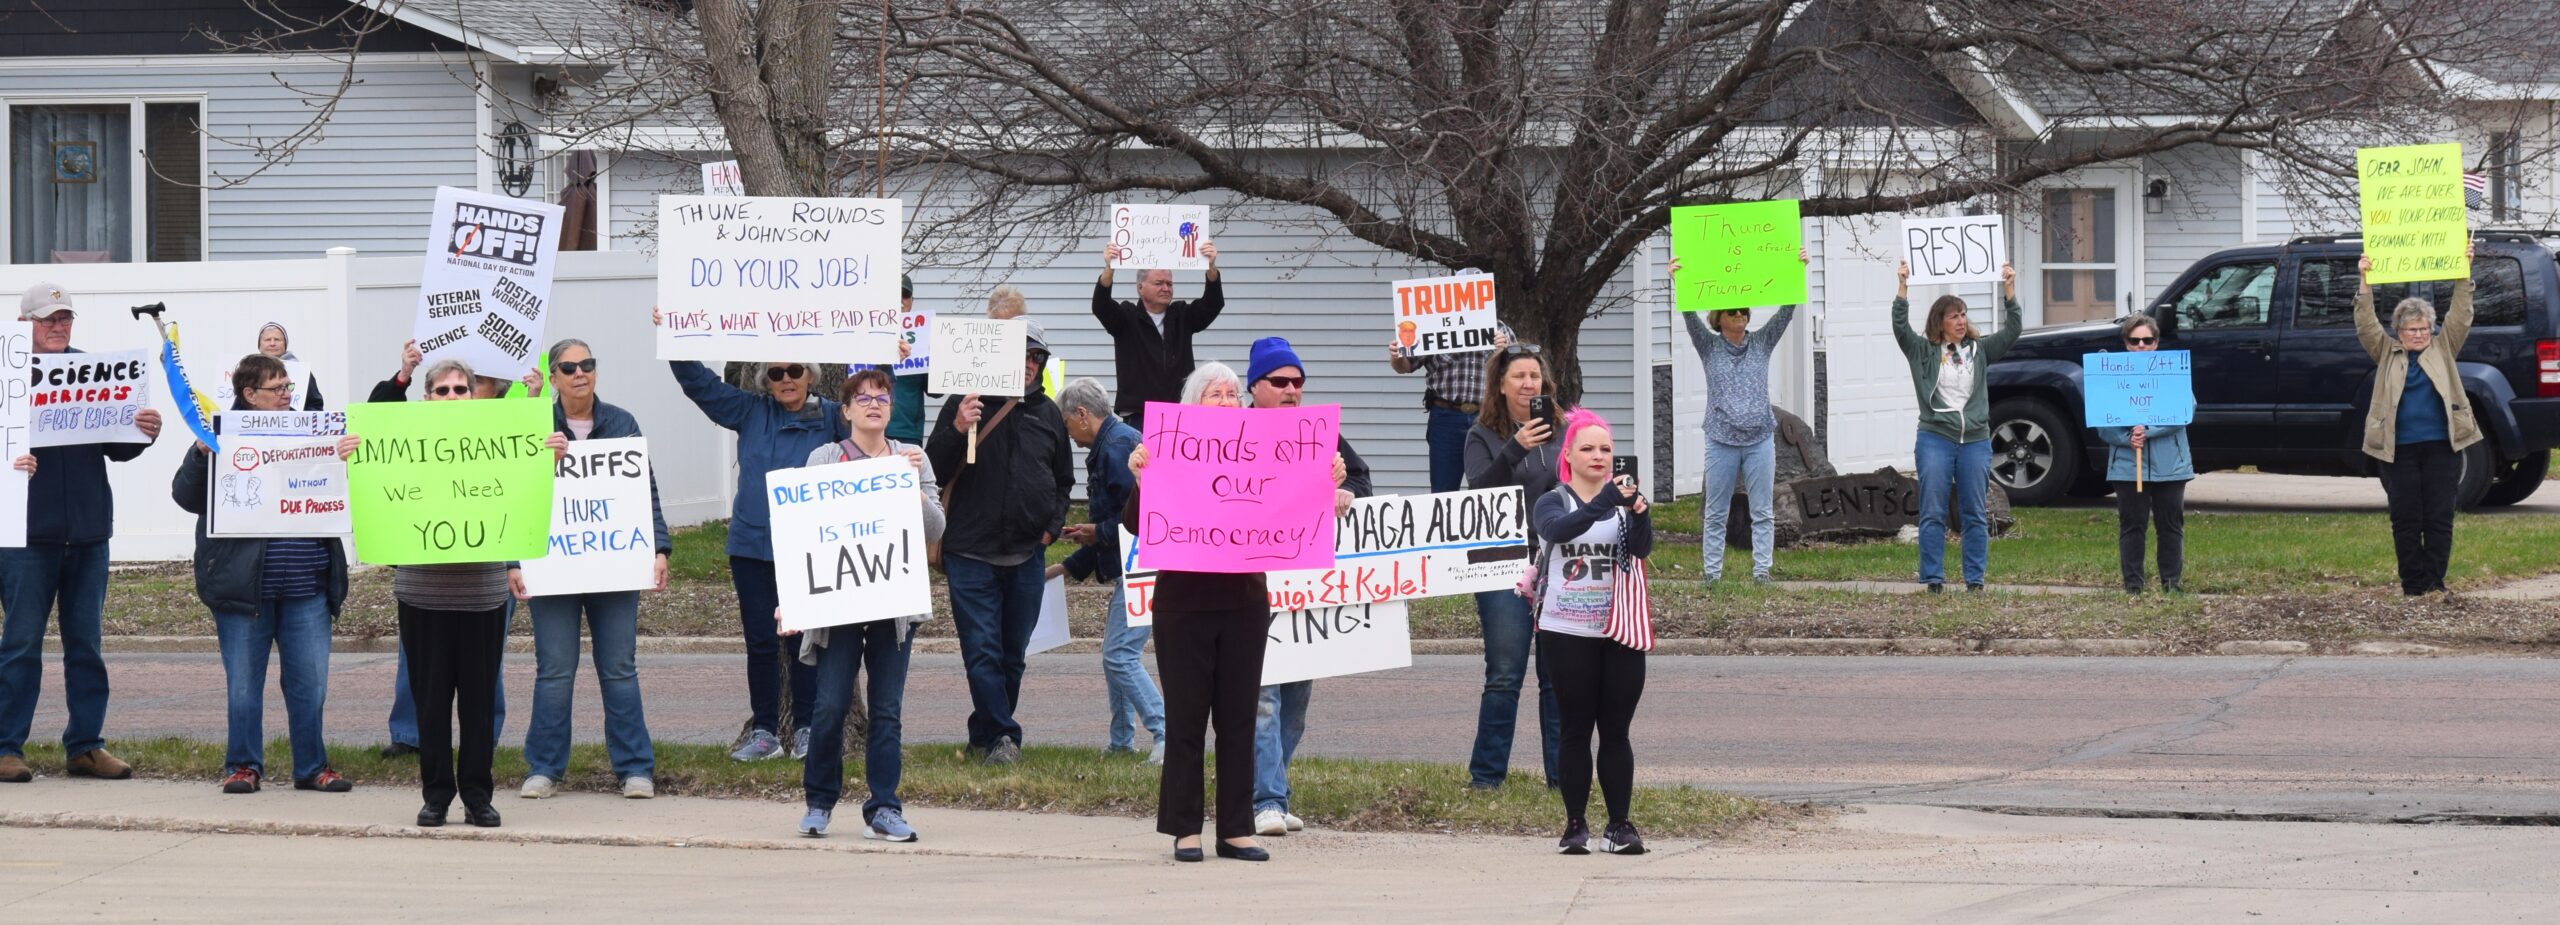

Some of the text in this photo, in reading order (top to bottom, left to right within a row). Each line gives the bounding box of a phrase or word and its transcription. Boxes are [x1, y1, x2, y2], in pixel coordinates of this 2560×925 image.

[2367, 159, 2401, 178] DEAR
[2377, 183, 2455, 200] WE ARE OVER
[457, 205, 540, 234] HANDS
[792, 202, 886, 225] ROUNDS
[1115, 207, 1171, 229] Grand
[716, 223, 831, 244] & JOHNSON
[1693, 213, 1776, 241] Thune
[454, 223, 538, 263] OFF!
[1115, 229, 1178, 253] Oligarchy
[1728, 242, 1796, 256] is afraid
[1908, 223, 1998, 276] RESIST
[2421, 232, 2447, 247] WITH
[447, 257, 535, 278] NATIONAL DAY OF ACTION
[1119, 247, 1159, 269] Party
[1725, 262, 1743, 274] of
[2398, 256, 2411, 272] IS
[691, 253, 869, 290] DO YOUR JOB!
[427, 289, 481, 307] VETERAN
[491, 287, 538, 322] WORKERS
[496, 276, 543, 313] POSTAL
[1396, 279, 1494, 317] TRUMP
[429, 302, 482, 319] SERVICES
[665, 309, 899, 333] THAT'S WHAT YOU'RE PAID FOR
[1441, 315, 1466, 327] IS A
[419, 325, 469, 354] SCIENCE
[484, 311, 533, 354] SOCIAL
[964, 323, 1006, 336] THUNE
[1421, 327, 1496, 351] FELON
[477, 323, 527, 361] SECURITY
[952, 337, 1005, 354] CARE
[970, 356, 989, 369] for
[2101, 356, 2135, 372] Hands
[942, 369, 1022, 390] EVERYONE!!
[2117, 378, 2159, 390] We will
[30, 385, 132, 407] MERICA'S
[2129, 395, 2154, 407] NOT
[38, 404, 138, 433] FUTURE
[240, 412, 346, 437] SHAME ON US
[2106, 413, 2121, 424] Be
[353, 433, 545, 464] IMMIGRANTS:
[1148, 411, 1258, 465] Hands
[236, 452, 256, 463] STOP
[262, 446, 335, 465] DEPORTATIONS
[554, 450, 644, 479] RIFFS
[383, 477, 504, 502] We Need
[772, 472, 913, 506] DUE PROCESS
[1211, 474, 1277, 498] our
[280, 498, 345, 514] DUE PROCESS
[563, 496, 615, 525] HURT
[1801, 486, 1920, 520] LENTSC
[819, 518, 886, 543] IS THE
[1335, 488, 1525, 553] MAGA ALONE!
[546, 527, 649, 556] MERICA
[1146, 511, 1325, 560] Democracy!
[806, 528, 909, 595] LAW!
[1562, 557, 1617, 582] OF
[1266, 579, 1315, 613] uigi
